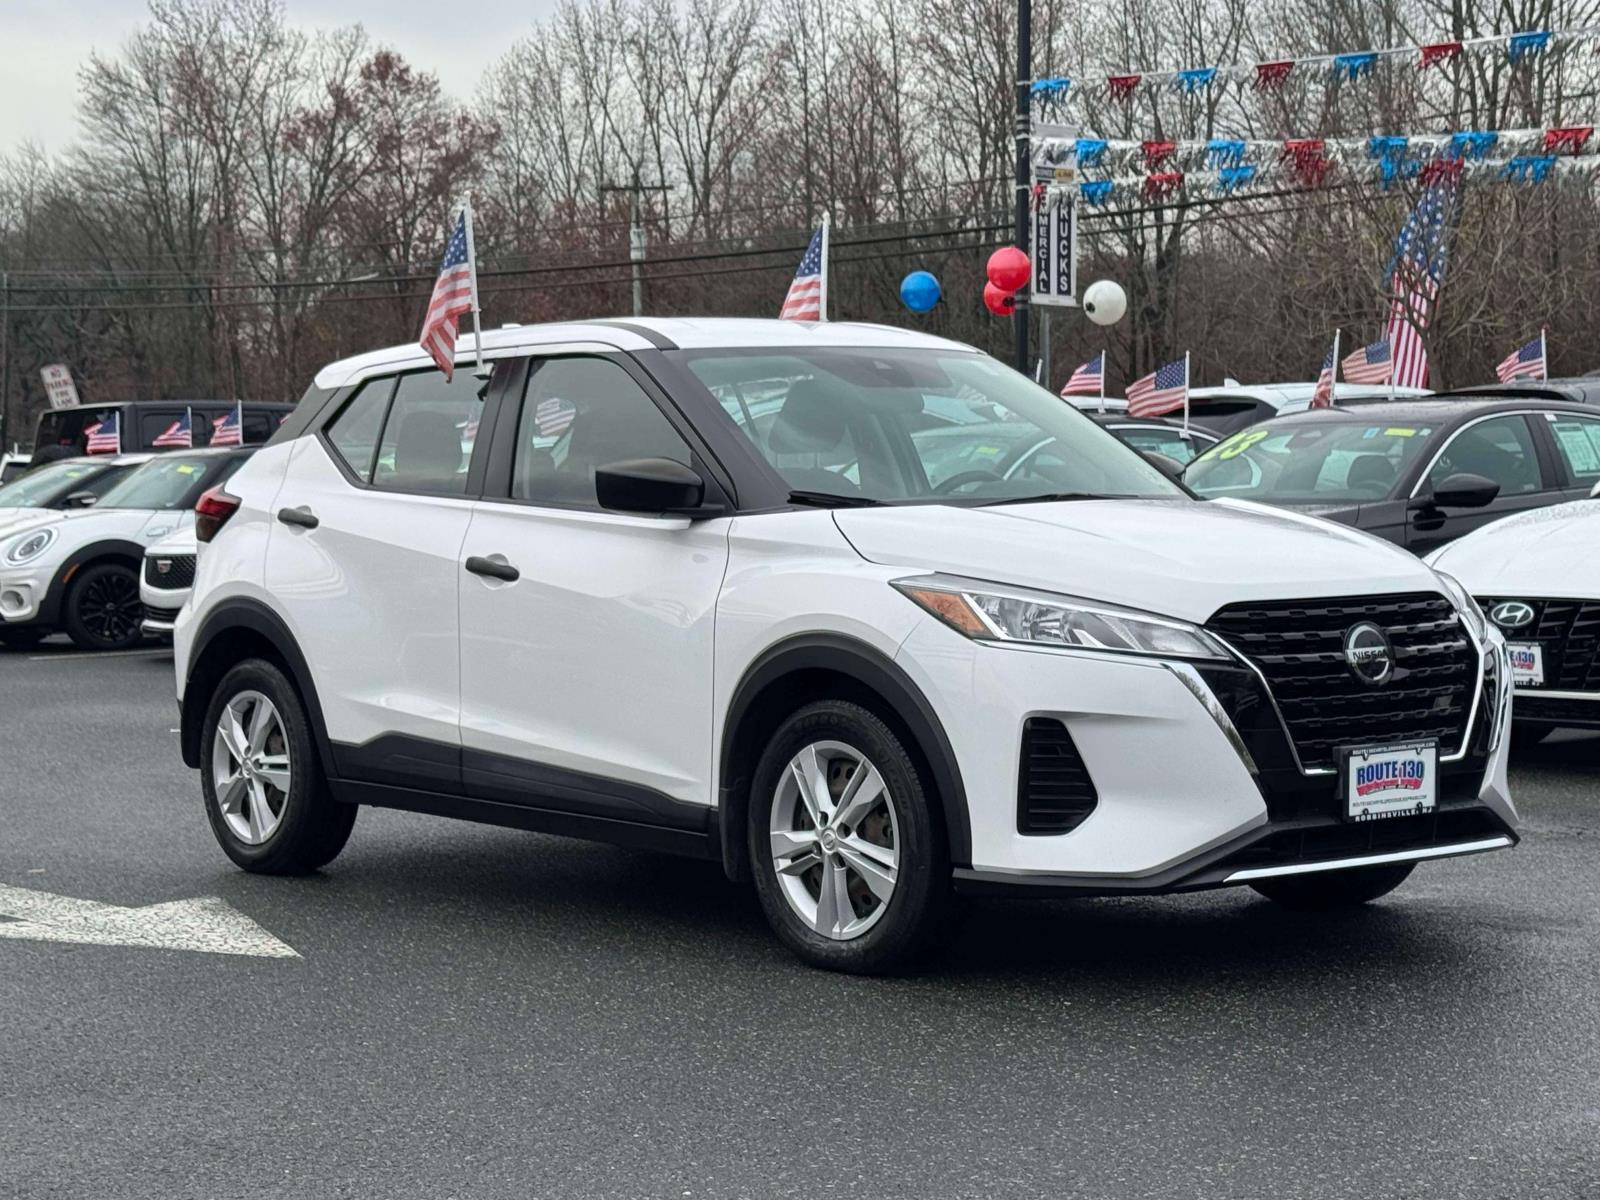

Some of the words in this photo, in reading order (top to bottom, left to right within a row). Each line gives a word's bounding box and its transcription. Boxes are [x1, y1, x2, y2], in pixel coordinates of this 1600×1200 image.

[1060, 190, 1069, 292] RUCKS
[1356, 760, 1398, 786] ROUTE
[1401, 760, 1425, 779] 130
